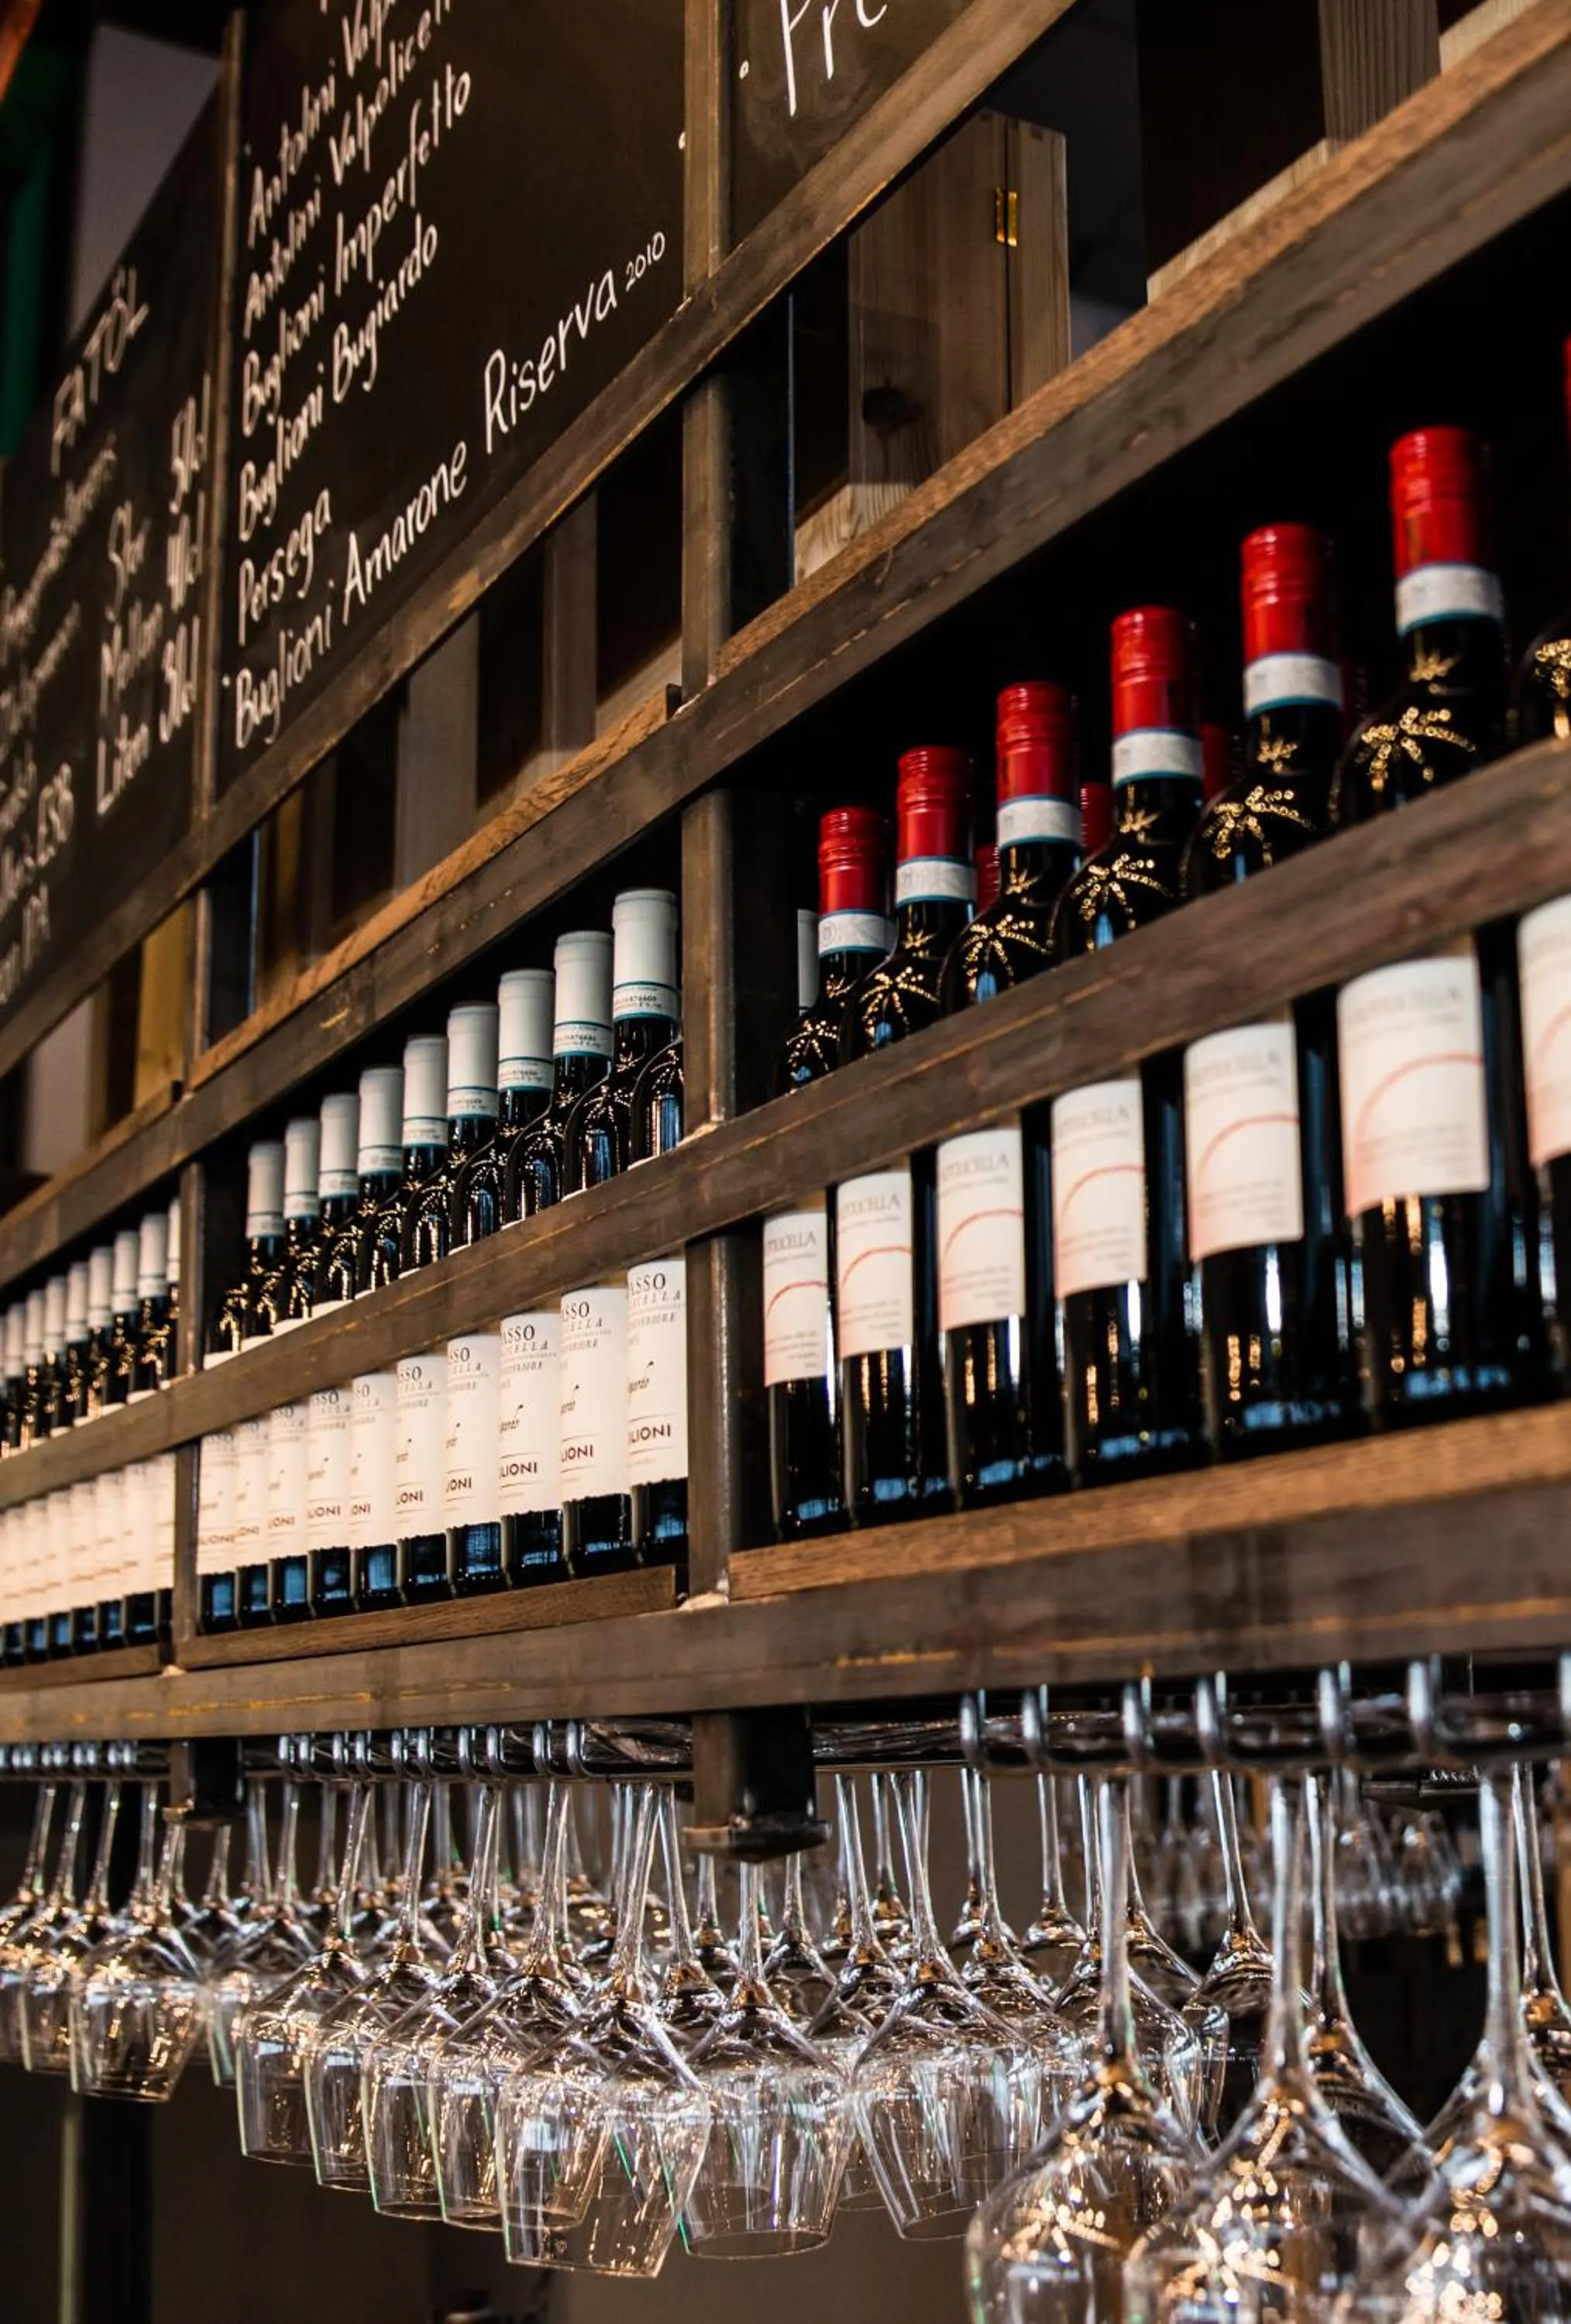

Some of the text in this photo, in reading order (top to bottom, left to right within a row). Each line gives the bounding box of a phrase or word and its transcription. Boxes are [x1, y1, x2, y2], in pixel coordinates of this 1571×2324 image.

[329, 0, 451, 186] Valpolice
[335, 62, 471, 297] Imperfetto
[235, 230, 666, 750] Buglioni Amarone Riserva 2010
[238, 212, 438, 543] Buglioni Bugiardo
[238, 486, 332, 648] Persega
